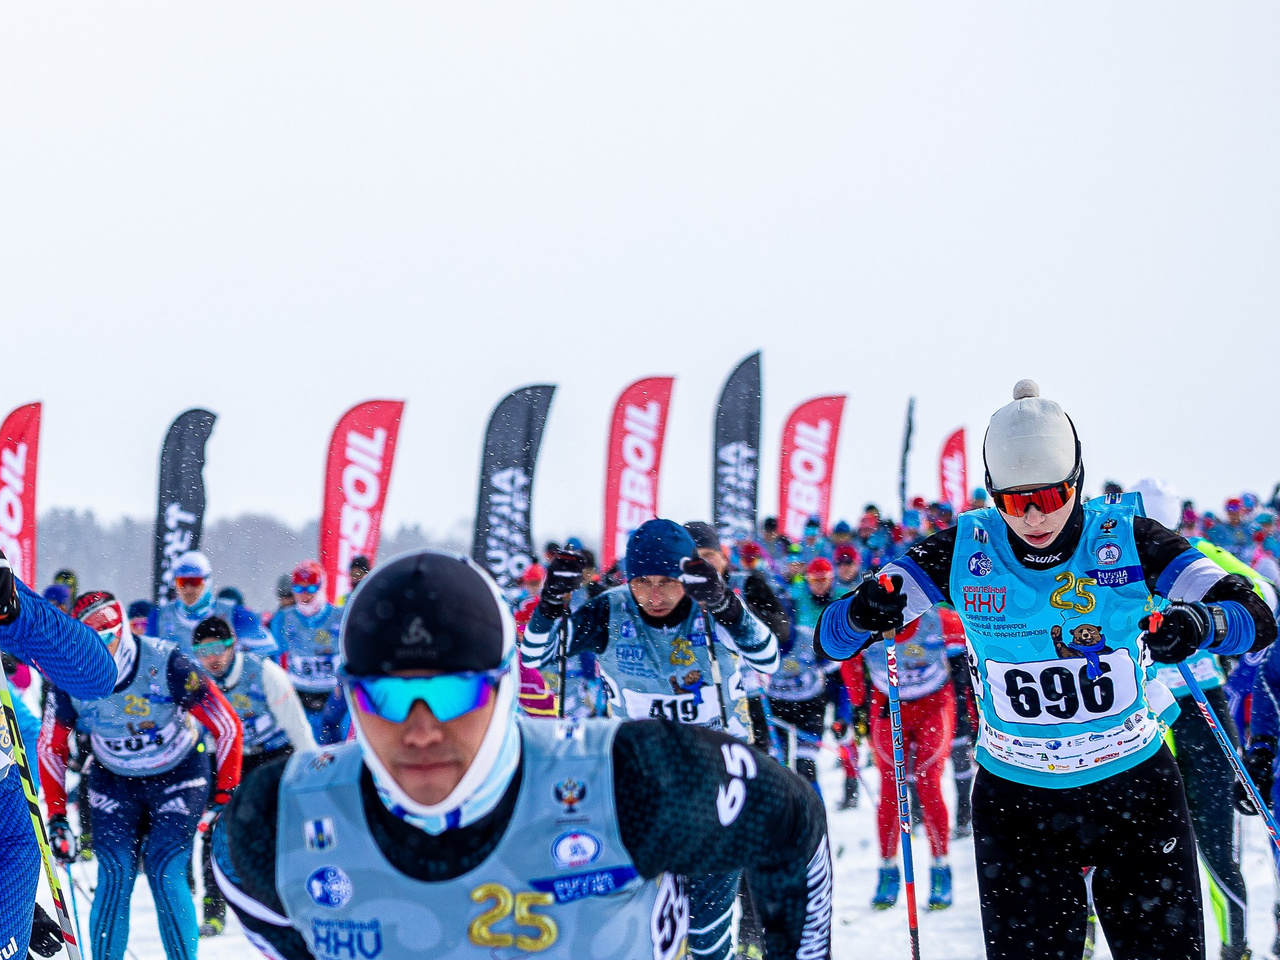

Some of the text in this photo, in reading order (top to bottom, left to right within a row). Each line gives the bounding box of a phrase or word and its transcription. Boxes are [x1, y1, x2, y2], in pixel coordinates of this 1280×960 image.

[1050, 571, 1098, 614] 25
[1097, 569, 1128, 579] RUSSIA
[648, 697, 700, 724] 419
[1003, 661, 1116, 720] 696
[467, 883, 559, 953] 25
